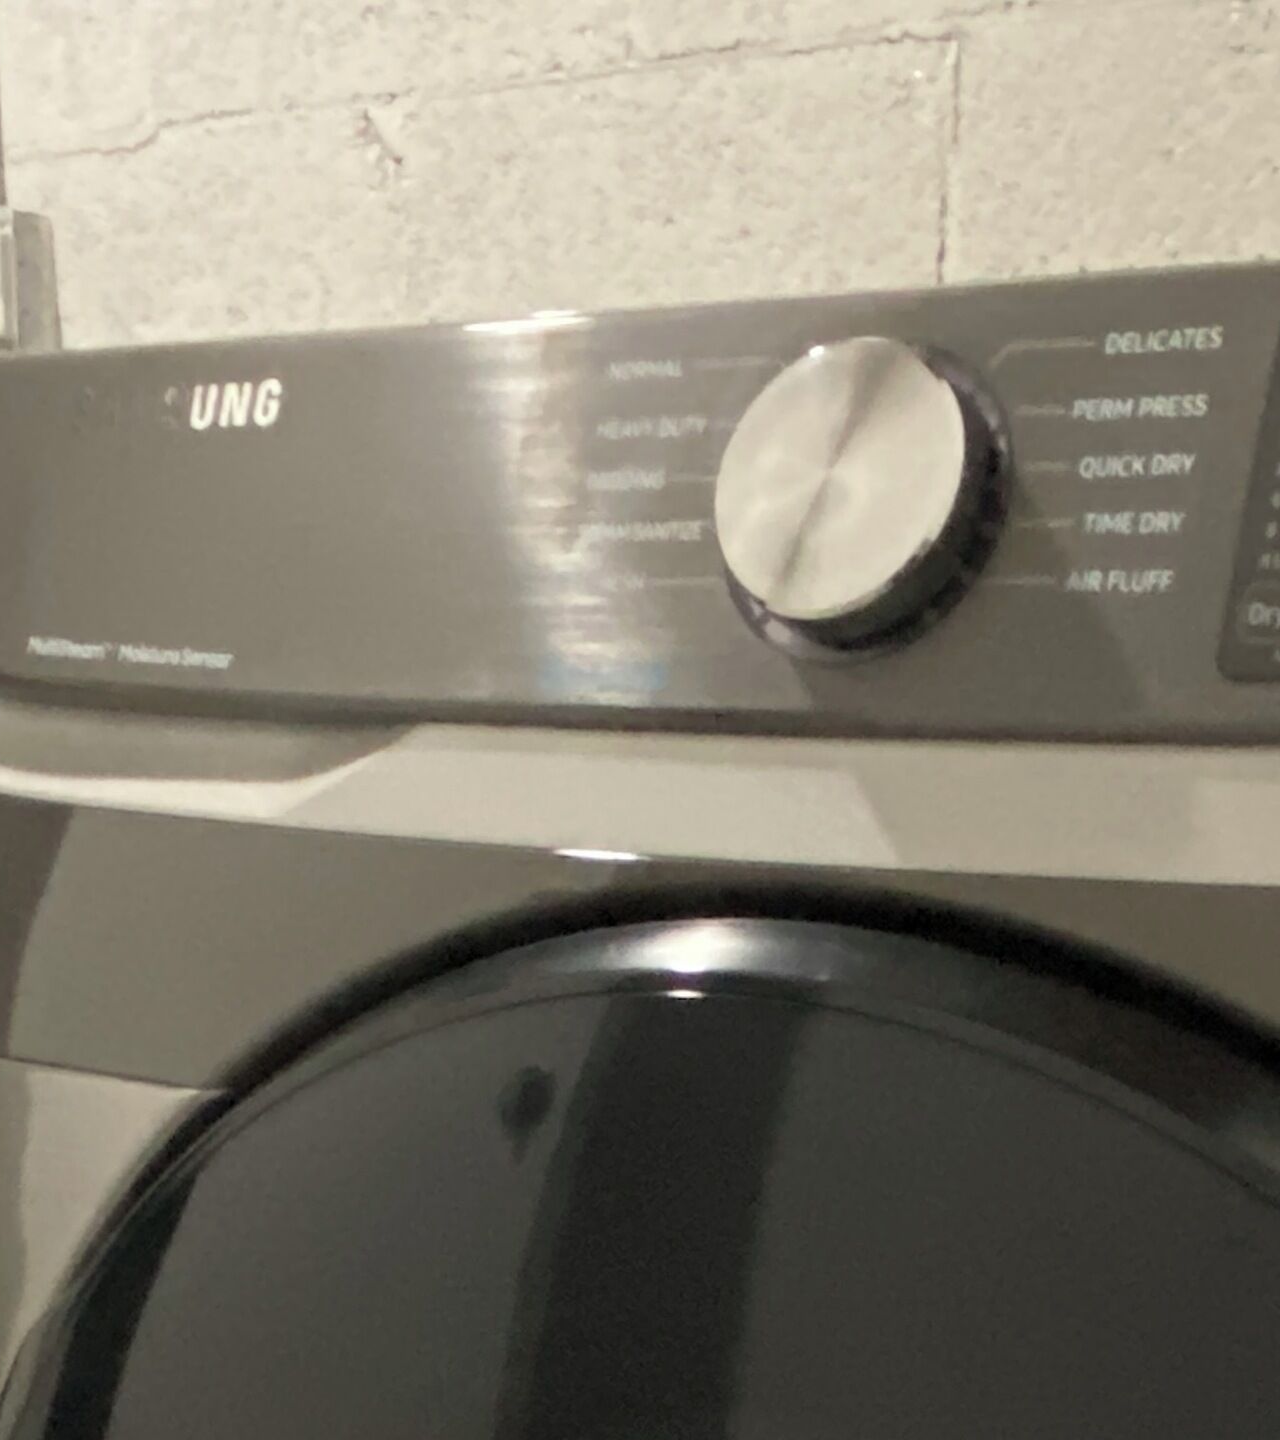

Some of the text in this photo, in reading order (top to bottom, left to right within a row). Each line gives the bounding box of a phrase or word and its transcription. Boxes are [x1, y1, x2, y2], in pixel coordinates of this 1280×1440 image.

[1103, 325, 1225, 355] DELICATES
[1070, 394, 1210, 421] PERM PRESS
[1078, 453, 1197, 480] QUICK DRY
[1083, 510, 1187, 534] TIME DRY
[1065, 569, 1176, 593] AIR FLUFF
